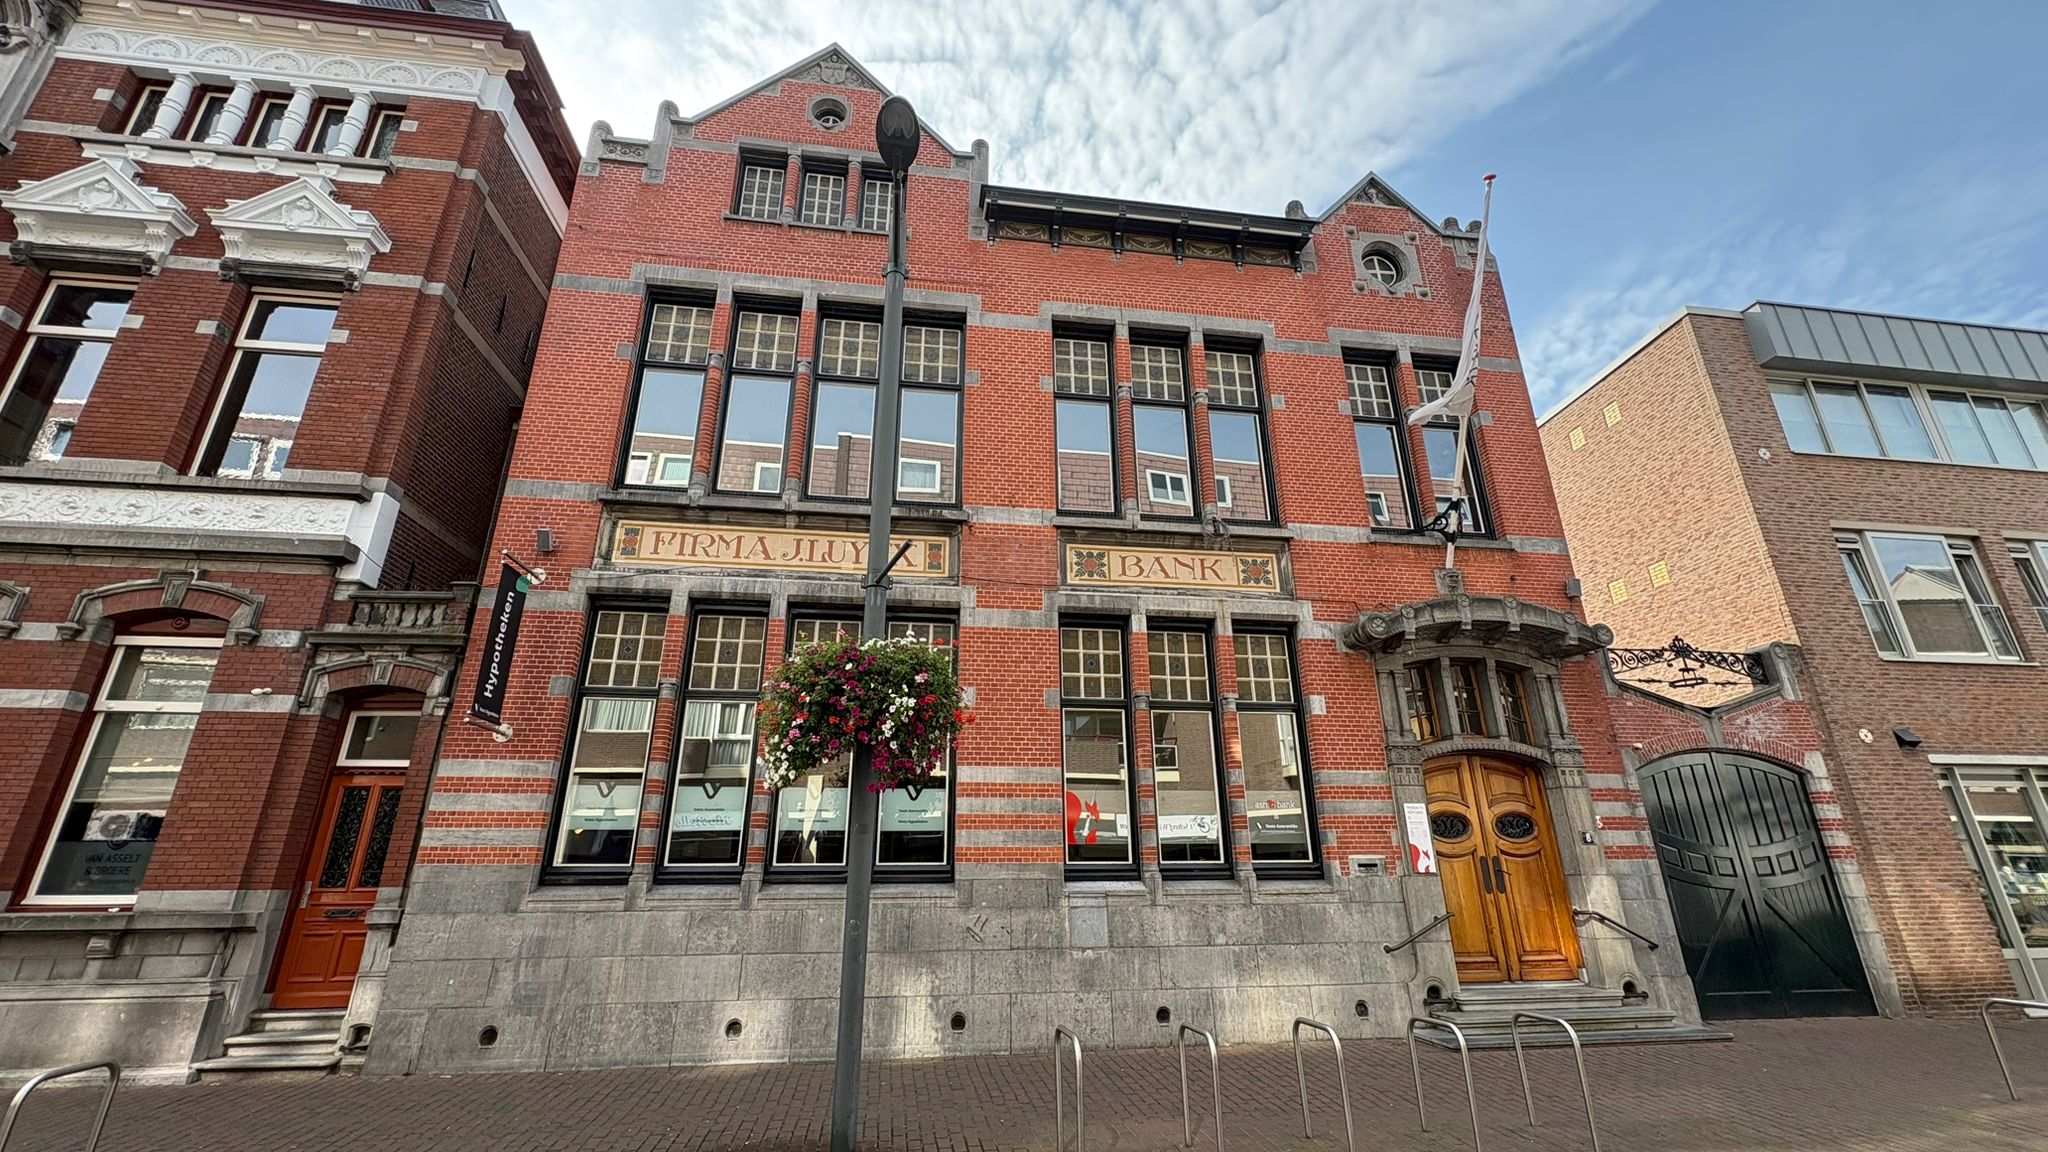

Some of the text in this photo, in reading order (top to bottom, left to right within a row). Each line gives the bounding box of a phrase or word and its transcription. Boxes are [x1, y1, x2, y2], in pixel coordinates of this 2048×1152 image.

[650, 530, 918, 567] FIRMA J.LUYX
[1118, 554, 1227, 581] BANK
[484, 591, 515, 698] Hypotheken
[1277, 800, 1296, 808] bank
[105, 853, 141, 864] ASSELT
